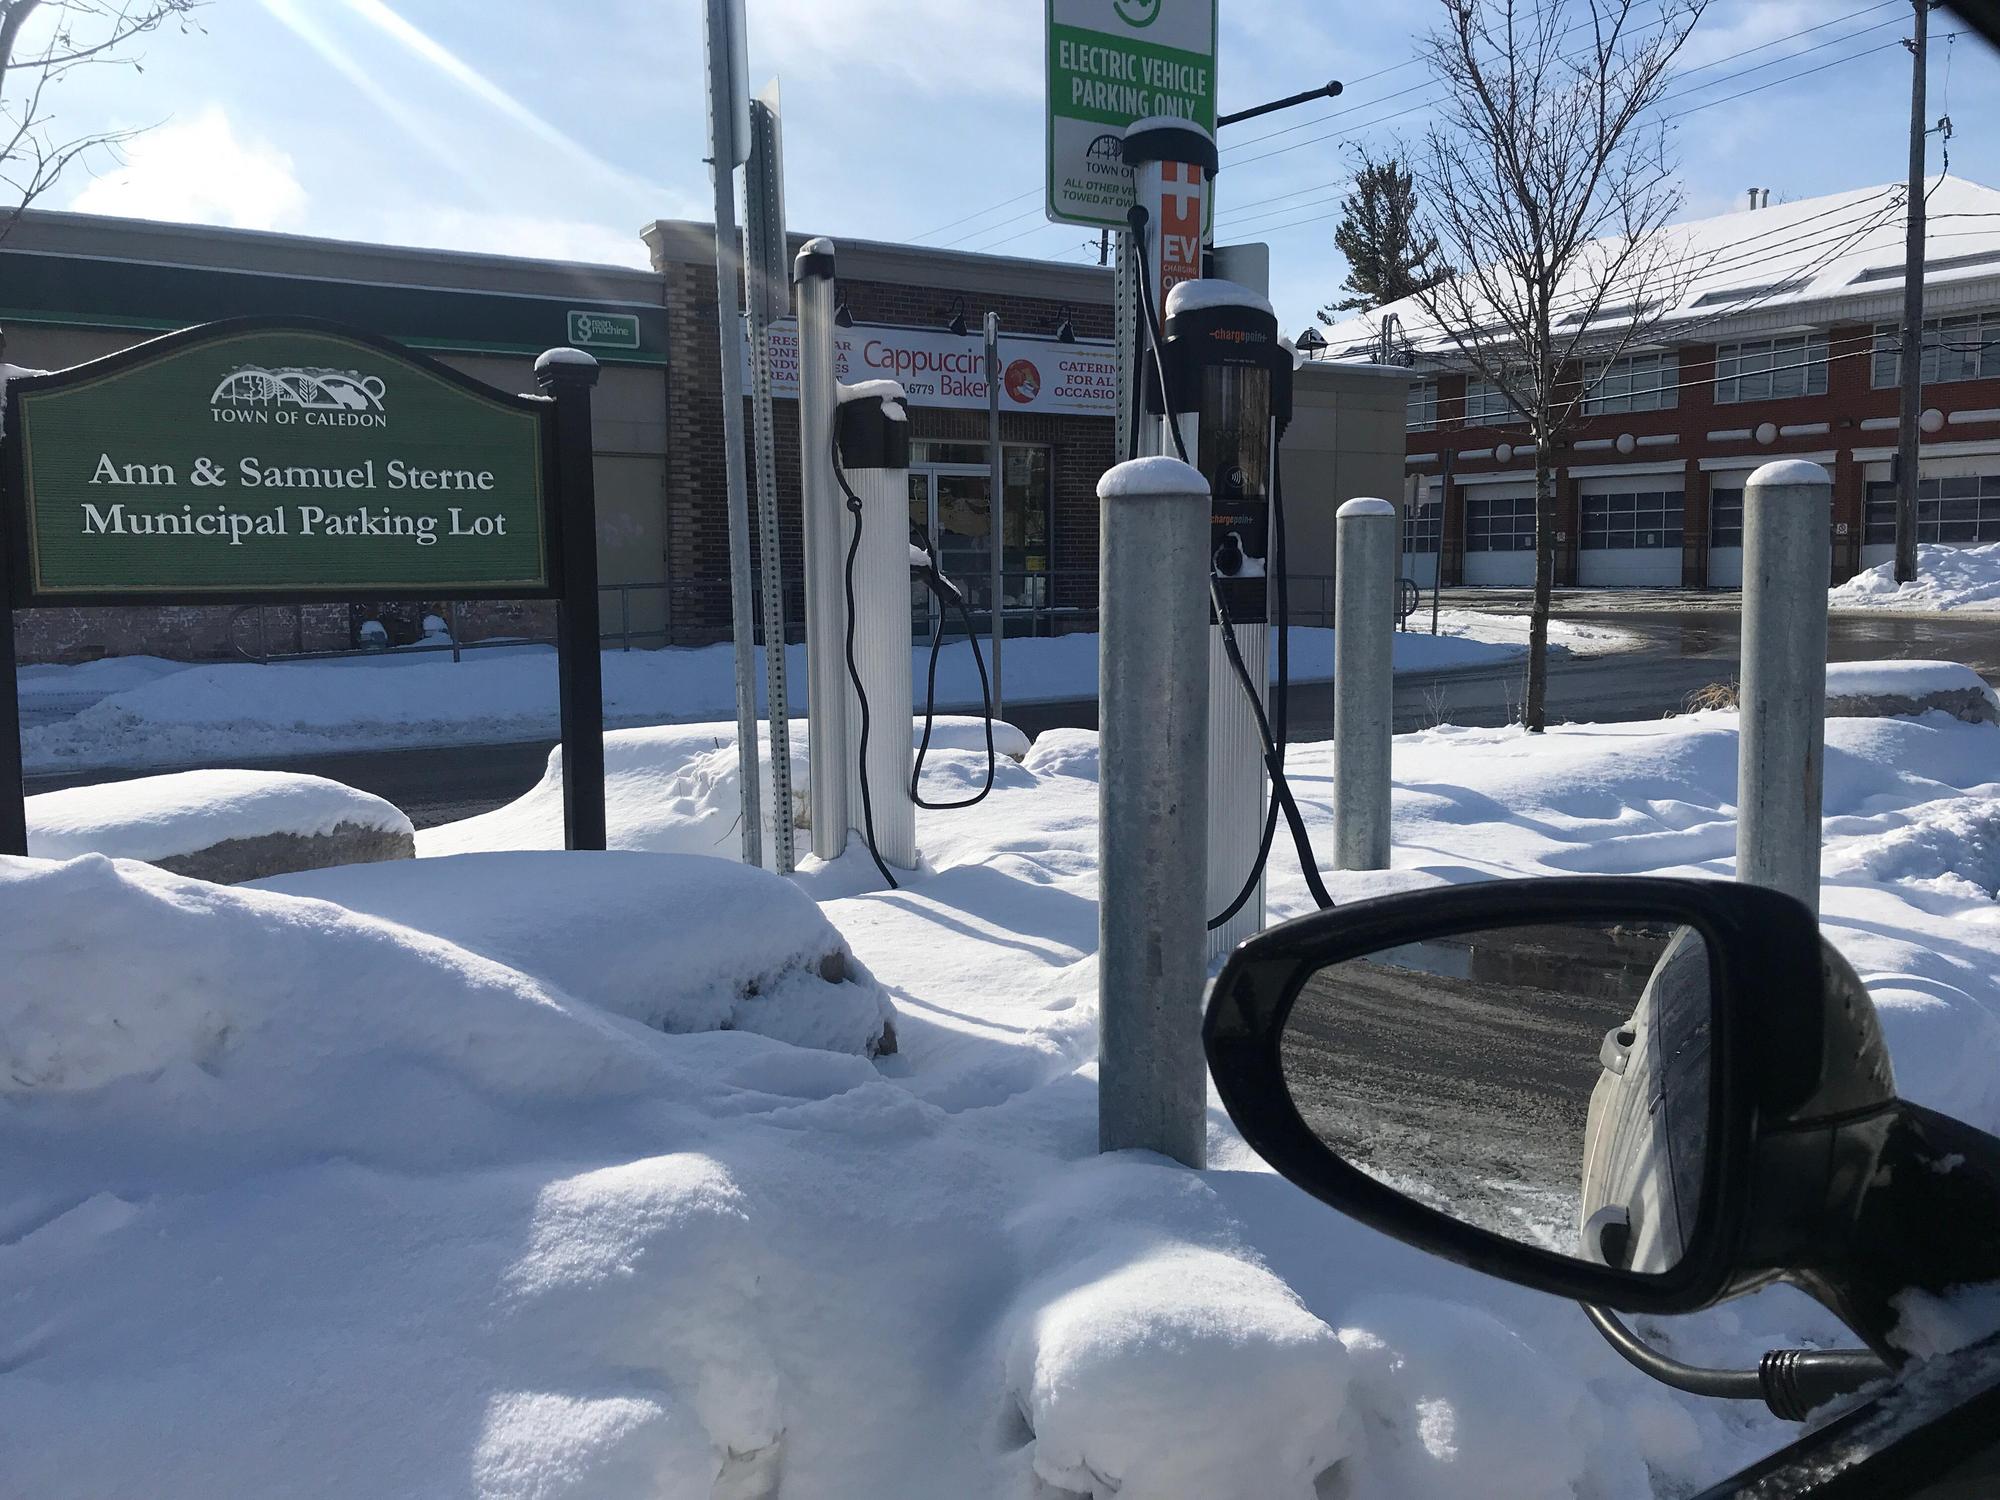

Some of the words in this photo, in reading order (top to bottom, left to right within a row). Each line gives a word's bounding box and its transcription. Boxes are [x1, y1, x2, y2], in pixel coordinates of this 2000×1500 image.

[1059, 40, 1136, 82] ELECTRIC
[1142, 56, 1206, 96] VEHICLE
[1072, 77, 1149, 117] PARKING
[1154, 93, 1195, 121] ONLY
[1086, 161, 1119, 176] TOWN
[1064, 177, 1084, 188] ALL
[1086, 181, 1120, 194] OTHER
[1063, 190, 1100, 204] TOWED
[1101, 195, 1115, 205] AT
[1164, 234, 1198, 263] EV
[592, 325, 629, 336] machine
[1059, 361, 1116, 374] CATERIN
[941, 375, 1001, 398] Baker
[1066, 374, 1093, 386] FOR
[1096, 377, 1114, 386] AL
[1054, 386, 1116, 399] OCCASIO
[211, 408, 268, 424] TOWN
[275, 411, 299, 425] OF
[305, 412, 387, 427] CALEDON
[88, 453, 176, 486] Ann
[190, 457, 226, 487] &
[239, 457, 376, 488] Samuel
[387, 459, 494, 490] Sterne
[81, 503, 288, 545] Municipal
[298, 506, 438, 546] Parking
[448, 507, 506, 536] Lot
